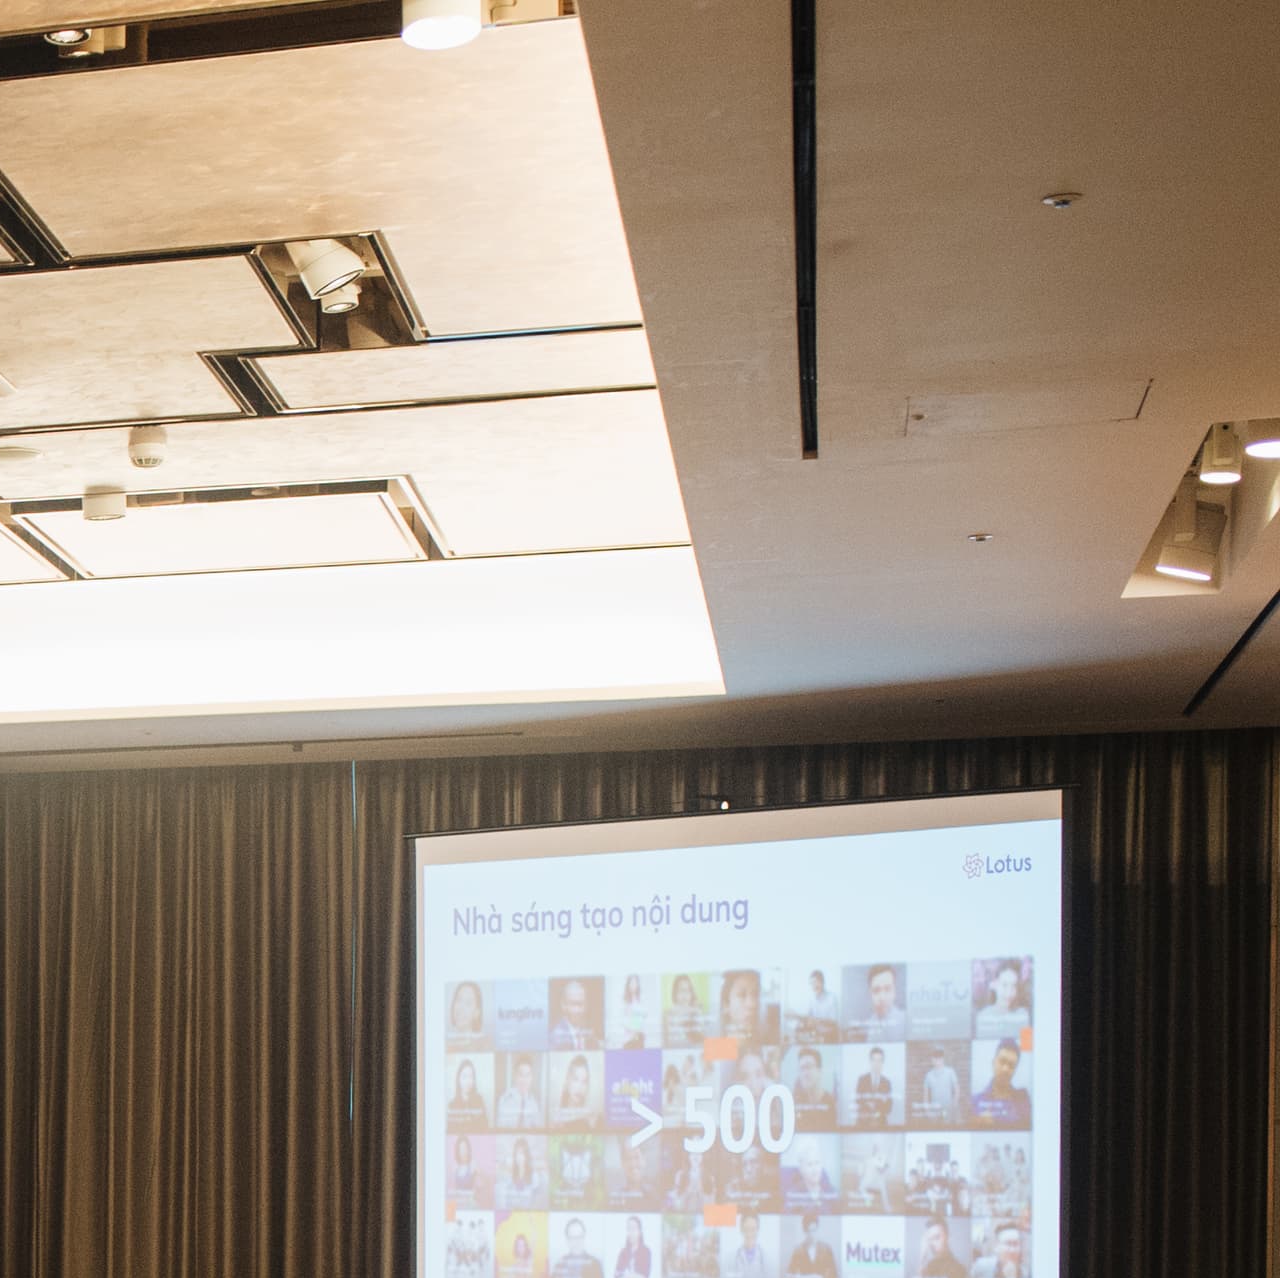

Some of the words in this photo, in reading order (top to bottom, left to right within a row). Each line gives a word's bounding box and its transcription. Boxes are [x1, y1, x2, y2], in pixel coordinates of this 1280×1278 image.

[985, 854, 1032, 875] Lotus
[452, 905, 503, 937] Nhà
[510, 903, 573, 939] sáng
[581, 904, 623, 938] tạo
[632, 896, 671, 935] nội
[680, 894, 750, 931] dung
[683, 1085, 796, 1153] 500
[845, 1240, 901, 1264] Mutex
